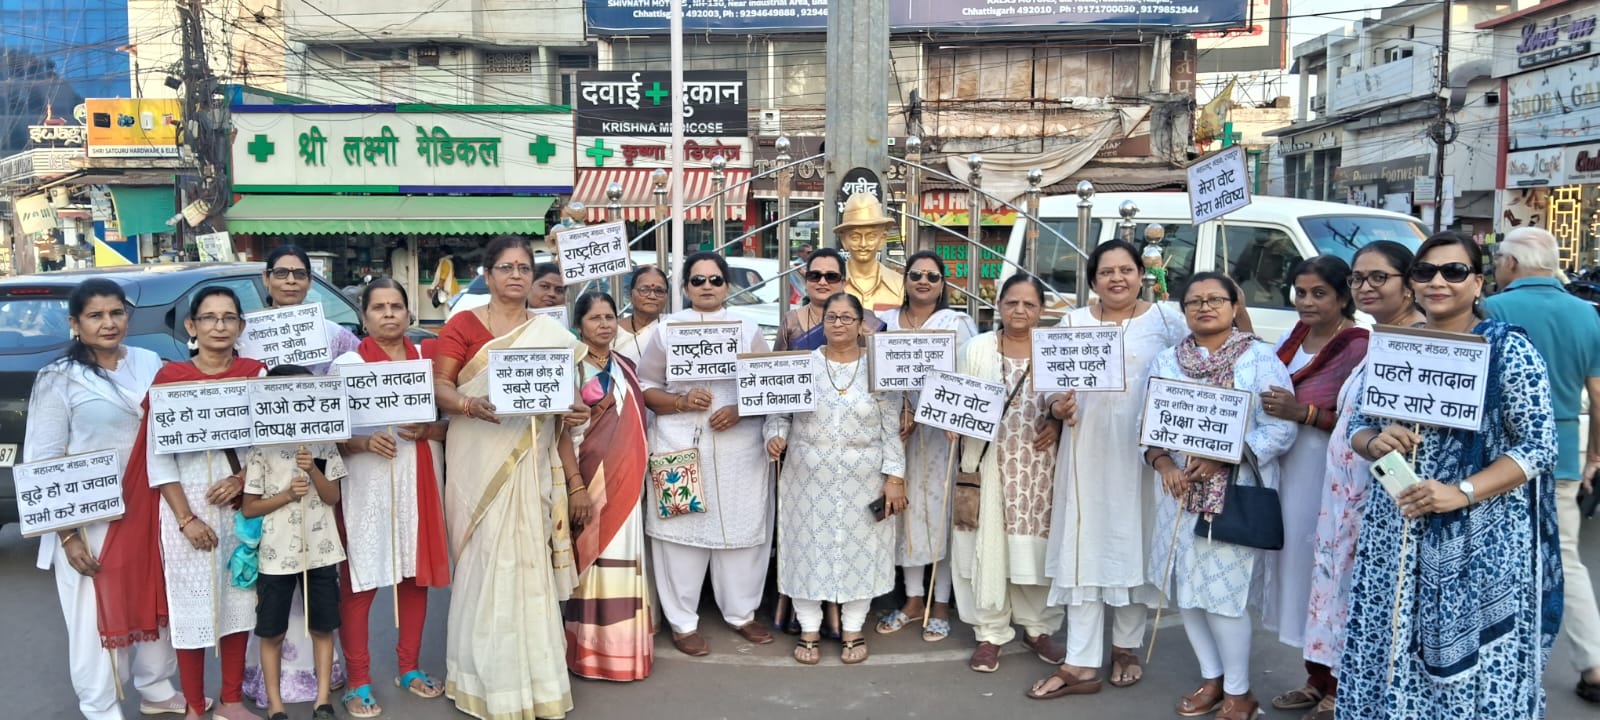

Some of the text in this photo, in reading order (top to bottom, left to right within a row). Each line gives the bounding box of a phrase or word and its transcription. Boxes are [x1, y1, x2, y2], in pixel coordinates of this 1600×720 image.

[652, 0, 692, 8] MOTS,
[962, 7, 1015, 16] Chhattisgarh
[1017, 6, 1056, 14] 492010,
[1141, 5, 1199, 13] 9179852944
[686, 10, 721, 19] 492003,
[581, 73, 643, 109] दवाई
[1512, 93, 1552, 115] SHOE
[602, 122, 724, 133] KRISHNA MEICOSE
[298, 126, 502, 168] श्री लक्ष्मी मेडिकल
[621, 144, 666, 166] कृष्णा
[1198, 170, 1236, 194] मेरा वोट
[924, 192, 944, 210] A-1
[1195, 187, 1244, 216] मेरा भविष्य
[564, 237, 622, 260] राष्ट्रहित में
[564, 258, 626, 278] करें मतदान
[955, 262, 1003, 279] SHKES
[248, 322, 314, 340] लोकतंत्र की पुकार
[263, 338, 306, 352] मत खोना
[672, 338, 738, 358] राष्ट्रहित में
[1041, 345, 1057, 356] सारे
[1060, 346, 1078, 356] काम
[1102, 343, 1112, 354] दो
[1388, 341, 1422, 354] महाराष्ट्र
[1453, 348, 1482, 362] रायपुर
[284, 348, 328, 364] अधिकार
[886, 349, 944, 362] लोकतंत्र की पुकार
[1046, 357, 1106, 372] सबसे पहले
[496, 367, 513, 378] सारे
[516, 368, 534, 377] काम
[555, 365, 564, 376] दो
[670, 360, 694, 376] करें
[896, 365, 910, 373] मत
[1374, 361, 1477, 390] पहले मतदान
[346, 372, 426, 388] पहले मतदान
[502, 379, 560, 394] सबसे पहले
[739, 373, 812, 388] हमें मतदान का
[880, 377, 908, 387] अपना
[1056, 374, 1097, 388] वोट दो
[224, 386, 246, 396] रायपुर
[374, 392, 432, 408] सारे काम
[742, 389, 812, 406] फर्ज निभाना है
[934, 386, 991, 413] मेरा वोट
[1220, 394, 1243, 406] रायपुर
[256, 395, 340, 415] आओ करें हम
[513, 395, 552, 409] वोट दो
[1154, 398, 1238, 418] युवा शक्ति का है काम
[1367, 386, 1478, 420] फिर सारे काम
[154, 408, 176, 428] बूढ़े
[197, 409, 210, 420] या
[214, 406, 250, 418] जवान
[920, 402, 995, 434] मेरा भविष्य
[1160, 410, 1228, 434] शिक्षा सेवा
[158, 428, 250, 446] सभी करें मतदान
[254, 420, 344, 438] निष्पक्ष मतदान
[1150, 426, 1234, 452] और मतदान
[91, 454, 114, 466] रायपुर
[20, 486, 42, 506] बूढ़े
[65, 482, 78, 493] या
[82, 474, 118, 490] जवान
[24, 496, 120, 526] सभी करें मतदान
